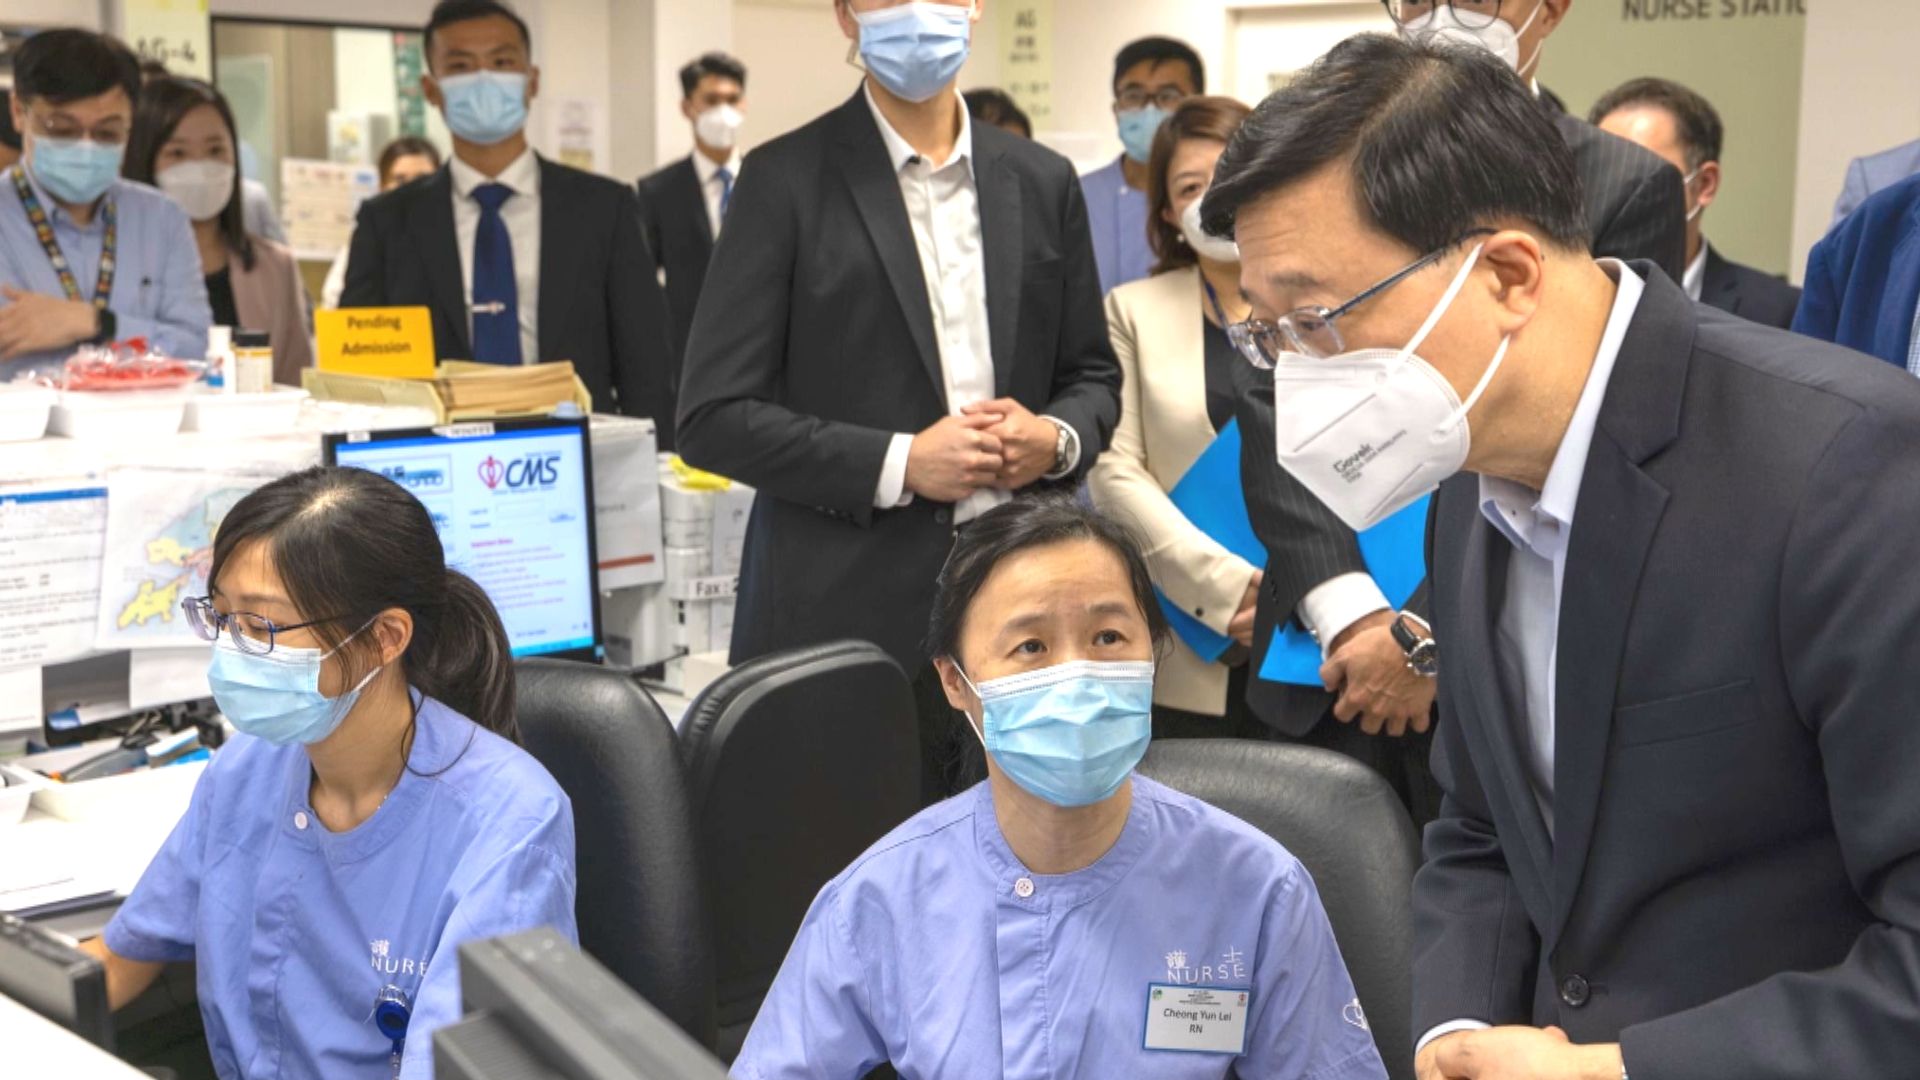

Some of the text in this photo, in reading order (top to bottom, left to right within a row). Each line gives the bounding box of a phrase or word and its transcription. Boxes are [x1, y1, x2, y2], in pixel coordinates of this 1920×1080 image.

[1623, 0, 1711, 20] NURSE
[347, 314, 401, 332] Pending
[342, 341, 410, 356] Admission
[505, 456, 561, 487] CMS
[1167, 965, 1245, 984] NURSE
[1163, 1008, 1198, 1021] Cheong
[1200, 1011, 1217, 1021] Yun
[1189, 1024, 1203, 1034] RN
